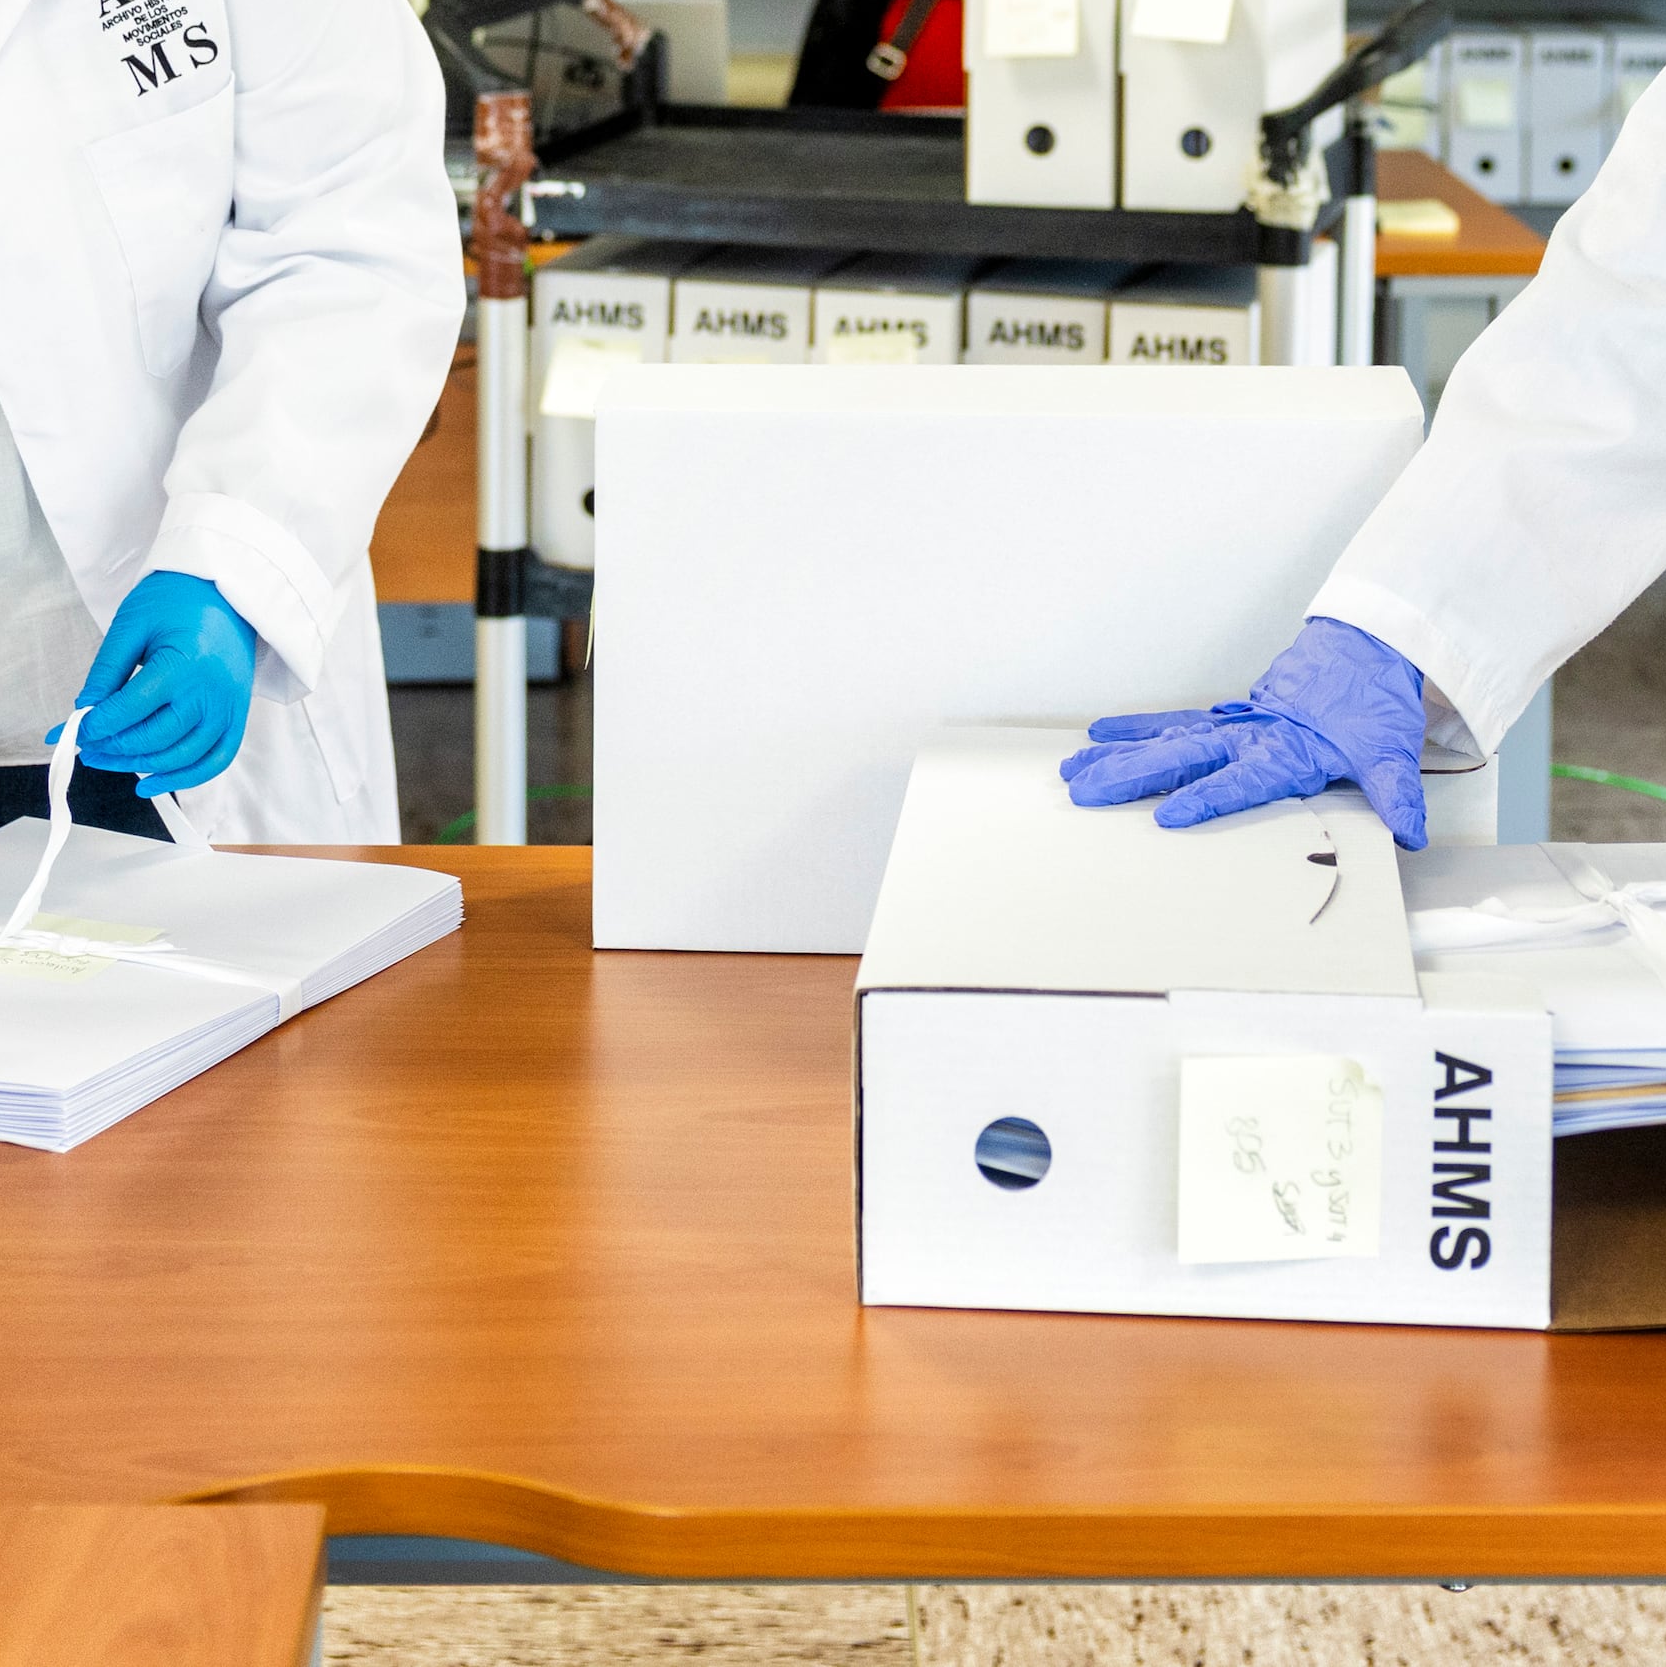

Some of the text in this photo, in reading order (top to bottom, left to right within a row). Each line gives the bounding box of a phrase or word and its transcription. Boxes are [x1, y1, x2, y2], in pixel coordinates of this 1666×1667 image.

[101, 5, 142, 32] ARCHIVO
[122, 6, 188, 43] MOVIMIENTOS
[134, 4, 168, 26] DE LOS
[136, 20, 183, 47] SOCIALES
[551, 298, 645, 331] AHMS
[695, 308, 789, 341] AHMS
[989, 318, 1085, 351] AHMS
[1130, 332, 1228, 365] AHMS
[1429, 1050, 1493, 1272] AHMS
